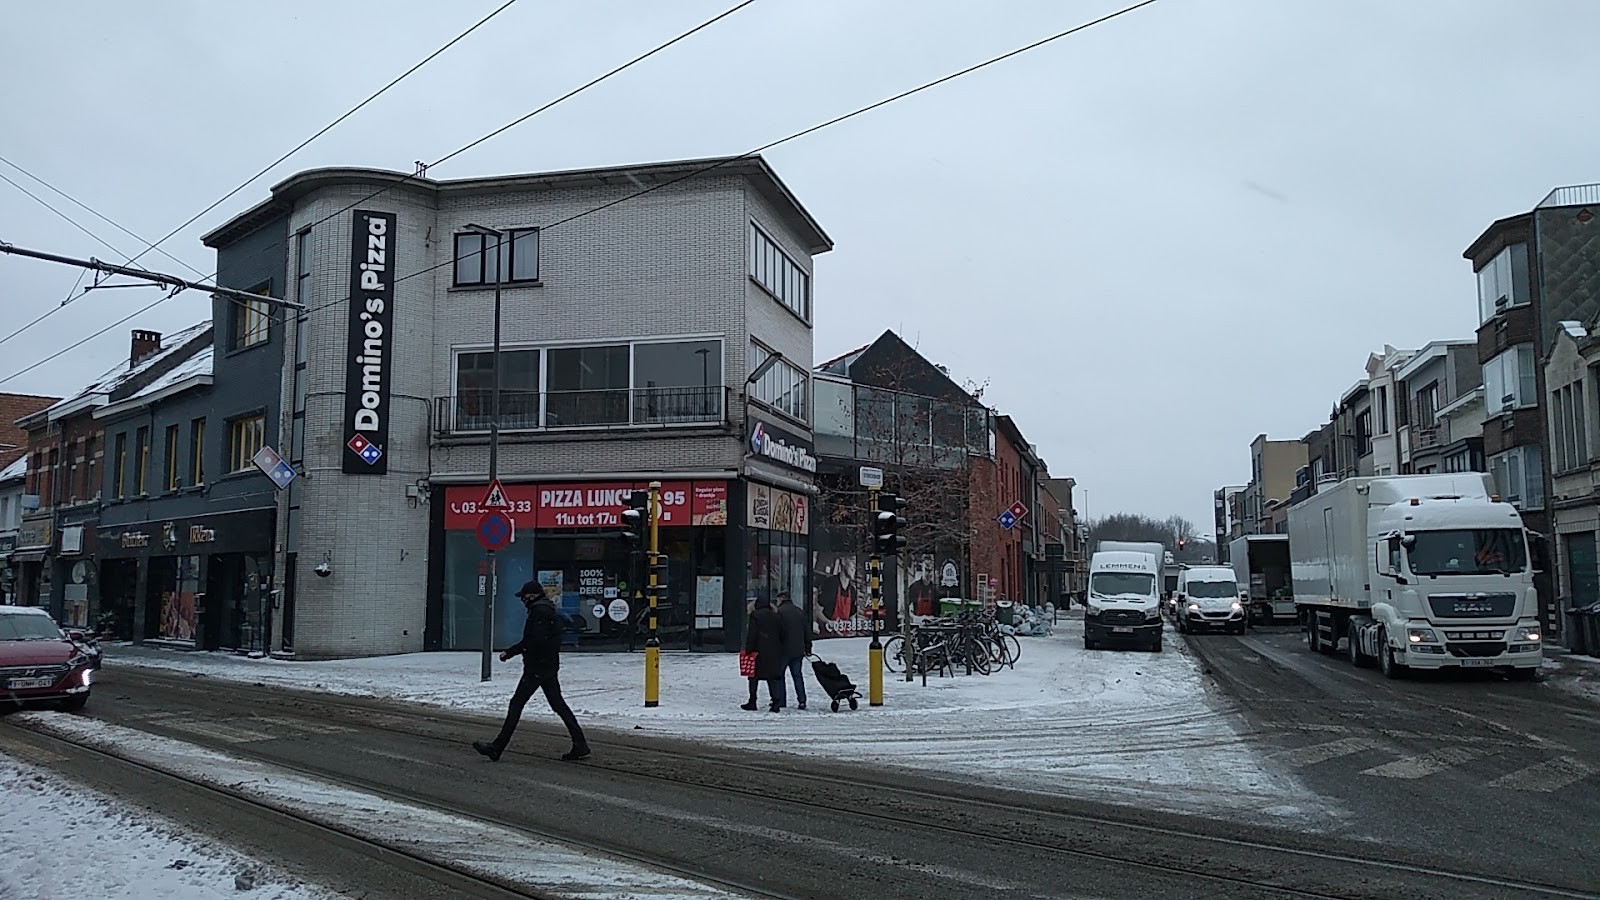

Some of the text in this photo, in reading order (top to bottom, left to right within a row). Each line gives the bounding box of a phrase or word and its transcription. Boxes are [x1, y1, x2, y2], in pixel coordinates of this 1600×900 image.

[354, 216, 386, 431] Domino's Pizza
[761, 432, 817, 473] Domino's Pizza
[541, 489, 583, 508] PIZZA
[461, 501, 476, 513] 03
[516, 500, 532, 513] 33
[555, 511, 618, 526] 11u tot 17u
[1100, 562, 1147, 571] LEMMENS
[579, 569, 604, 578] 100%
[579, 578, 604, 586] VERS
[579, 586, 604, 595] DEEG
